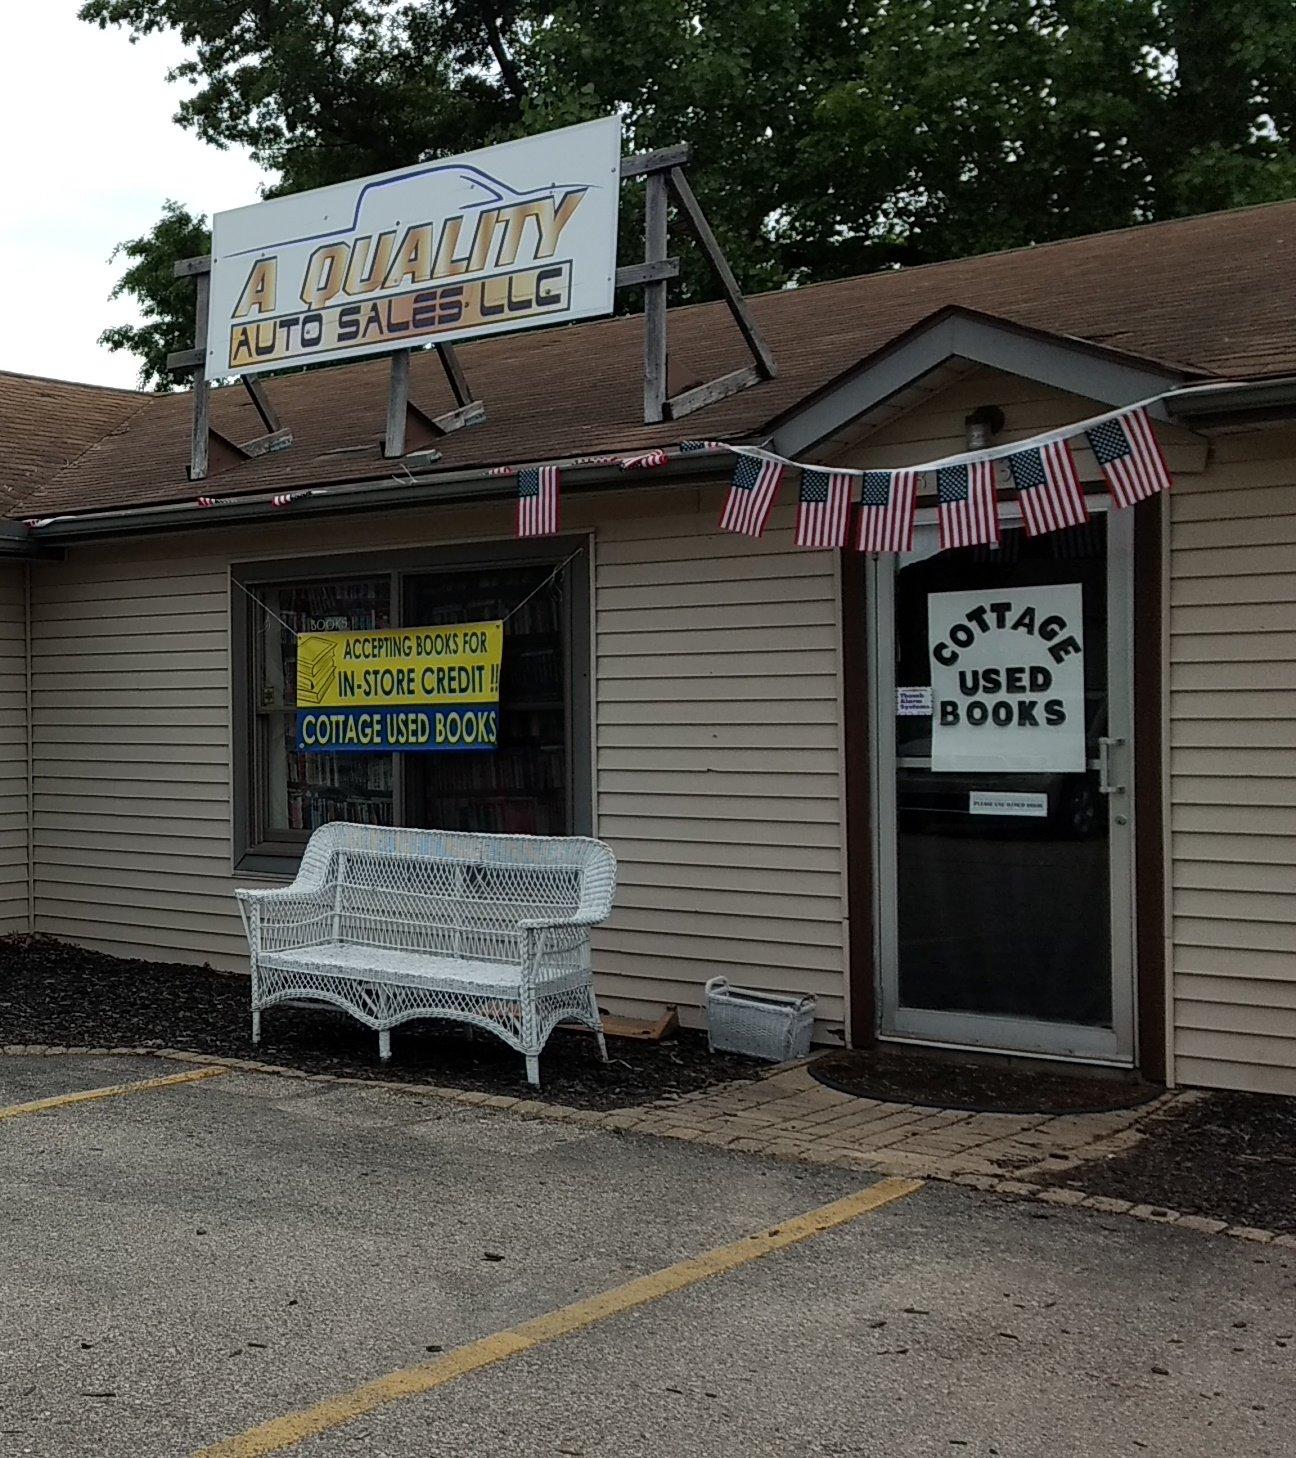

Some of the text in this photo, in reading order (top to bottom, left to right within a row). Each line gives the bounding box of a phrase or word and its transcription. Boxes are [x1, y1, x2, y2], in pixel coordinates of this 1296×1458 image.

[230, 187, 590, 319] A QUALITY
[232, 268, 564, 361] AUTO SALES LLC
[310, 618, 348, 631] BOOKS
[933, 602, 1082, 667] COTTAGE
[343, 631, 487, 660] ACCEPTING BOOKS FOR
[338, 667, 416, 697] IN-STORE
[421, 664, 485, 695] CREDIT
[958, 665, 1053, 697] USED
[303, 710, 497, 744] COTTAGE USED BOOKS
[940, 699, 1067, 727] BOOKS
